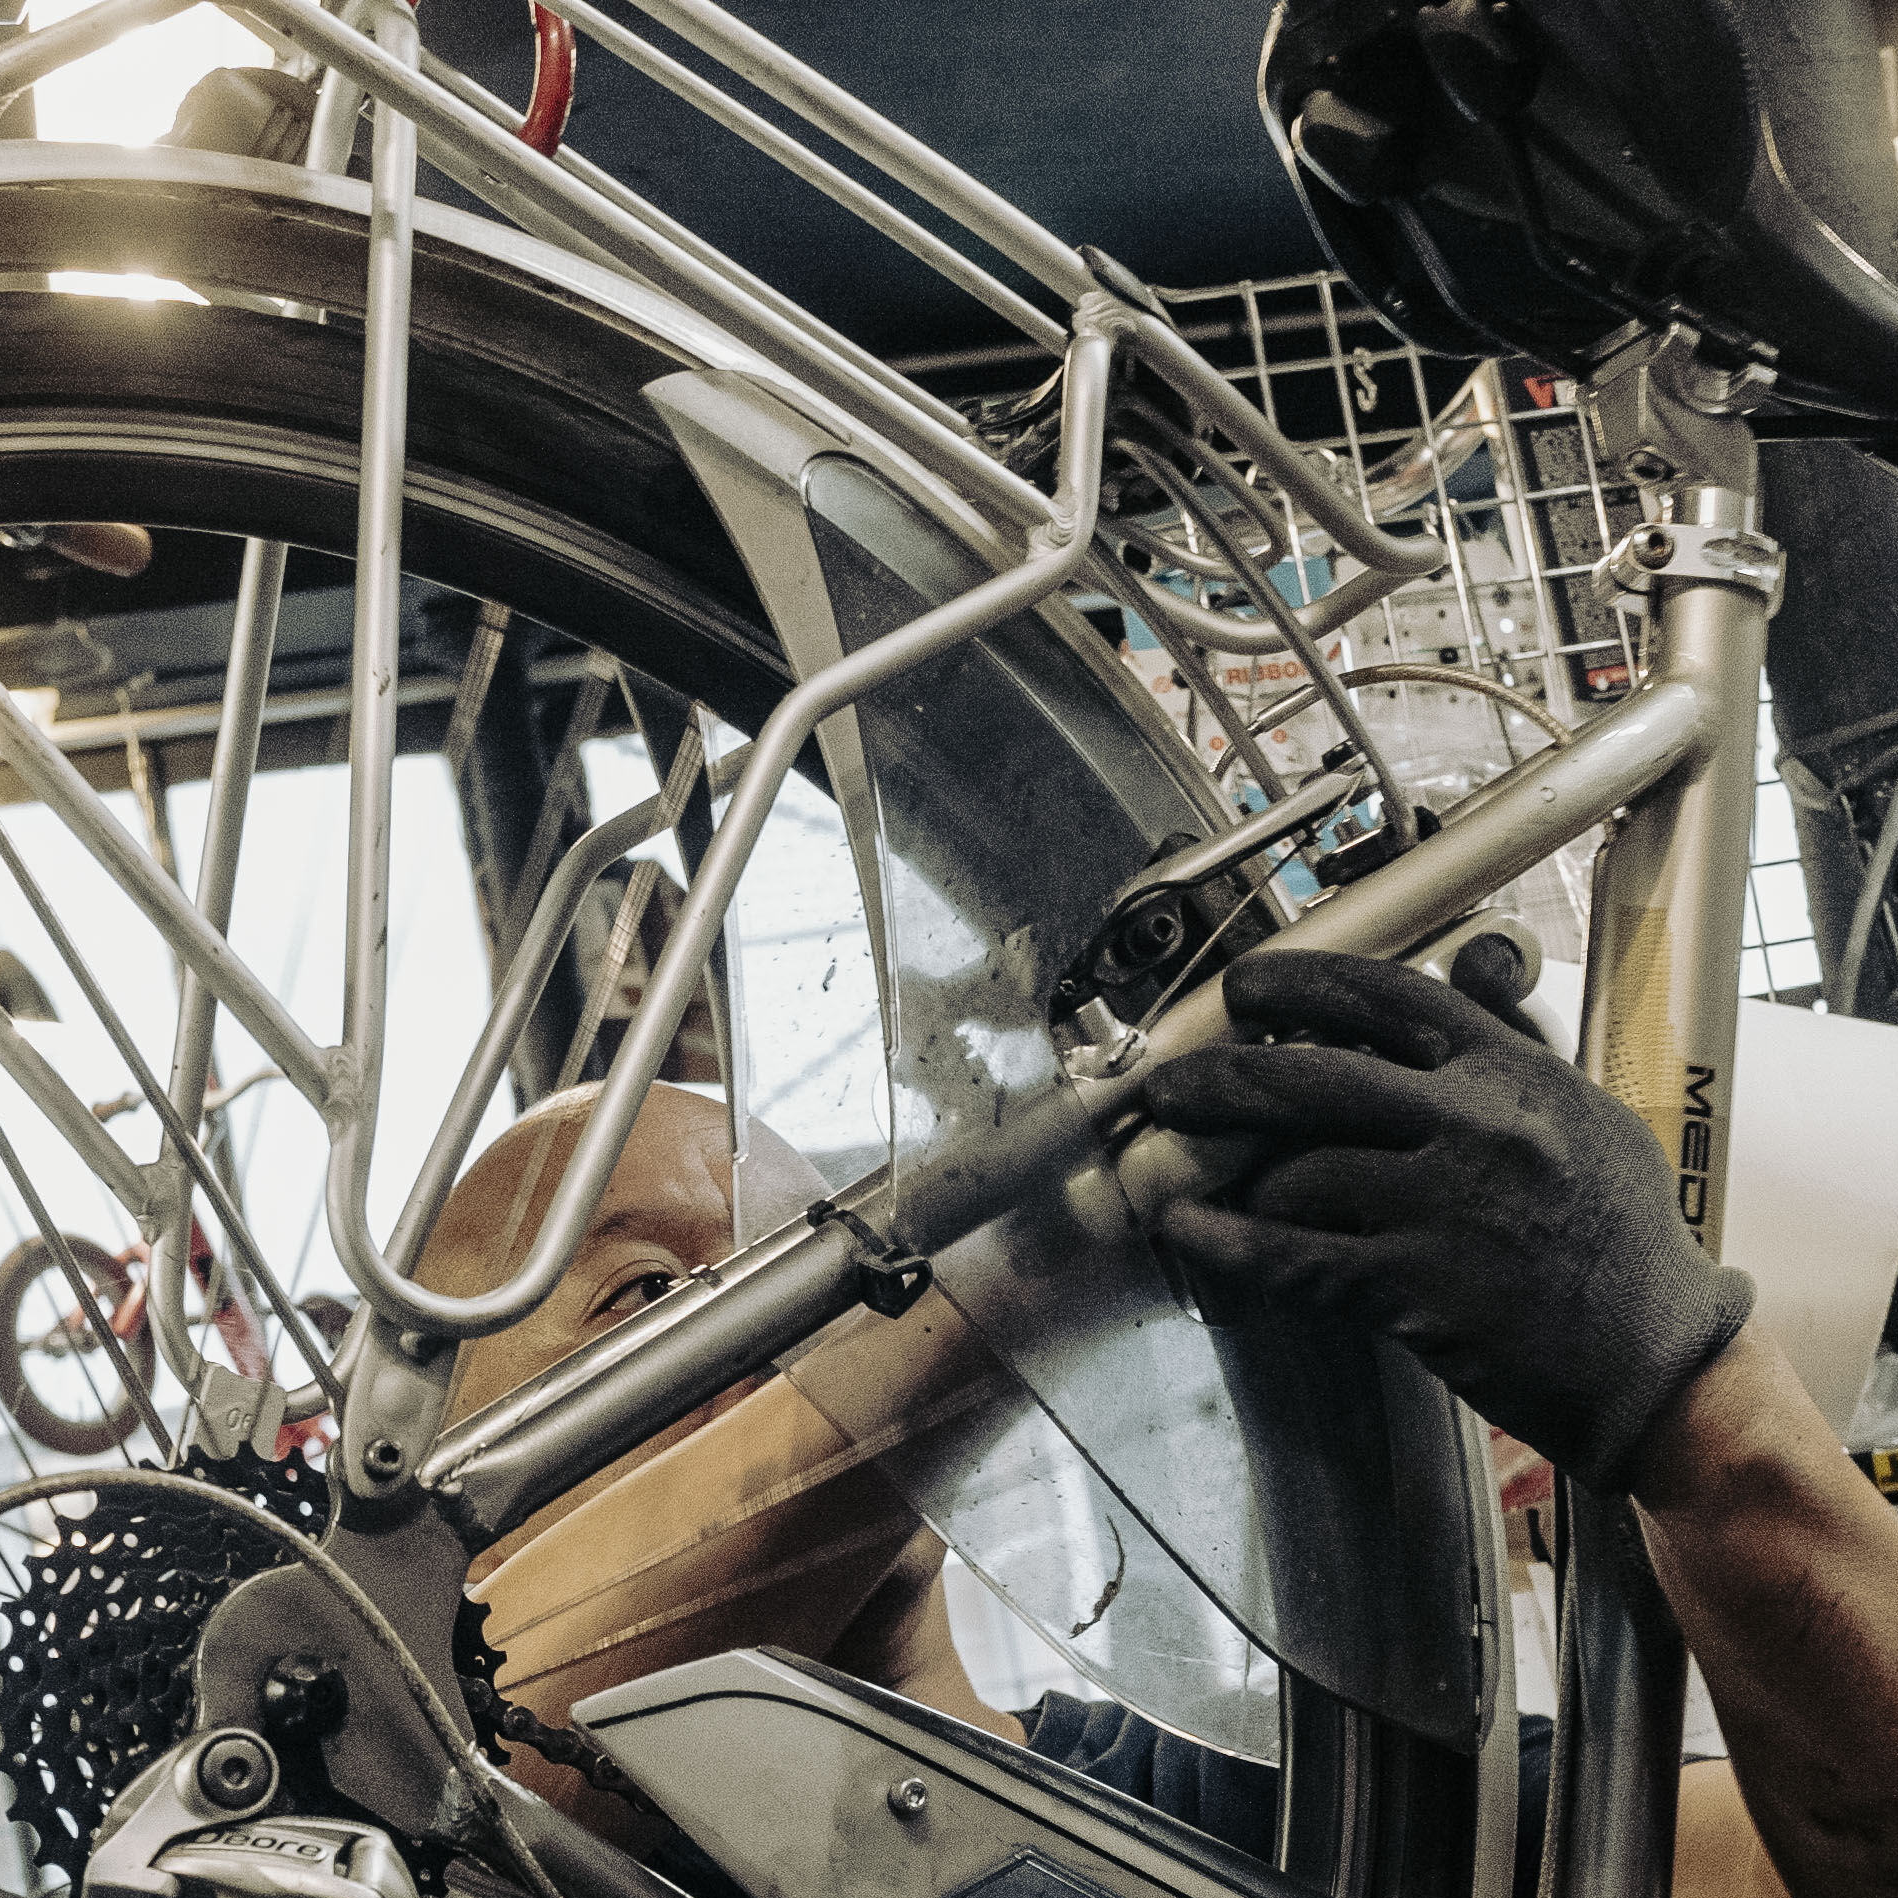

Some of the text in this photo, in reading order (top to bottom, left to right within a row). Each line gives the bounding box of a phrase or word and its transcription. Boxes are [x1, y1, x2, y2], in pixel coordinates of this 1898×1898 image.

[1226, 660, 1309, 686] RIBBO
[1679, 1065, 1715, 1247] MED
[195, 1830, 322, 1858] Deore
